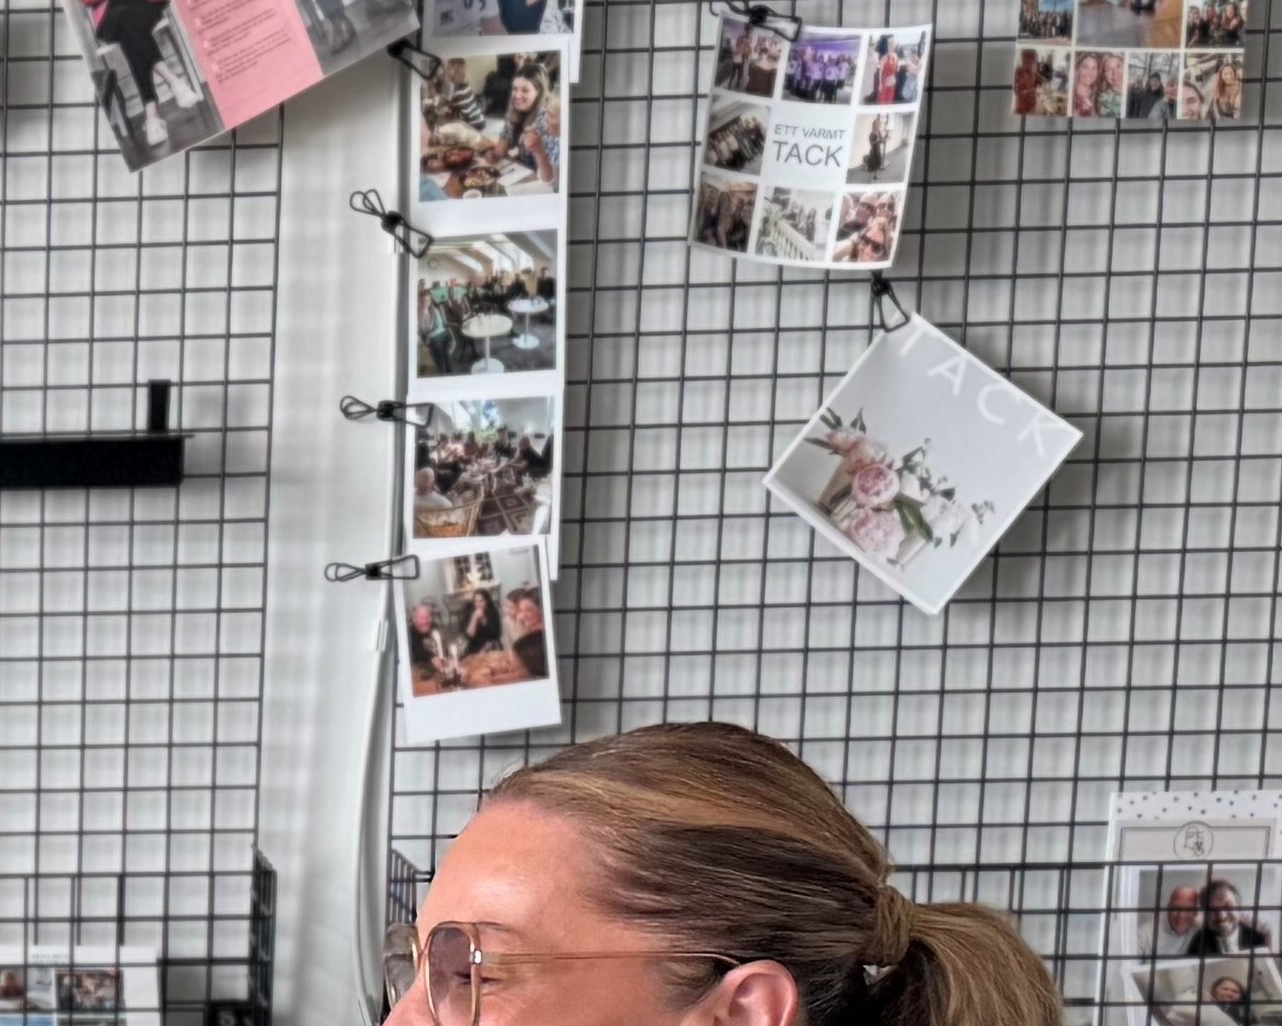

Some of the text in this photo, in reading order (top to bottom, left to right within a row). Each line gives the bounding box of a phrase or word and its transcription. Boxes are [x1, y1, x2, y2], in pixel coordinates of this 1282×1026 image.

[774, 123, 846, 140] ETT VARMT
[772, 140, 843, 168] TACK
[899, 320, 1073, 460] TACK
